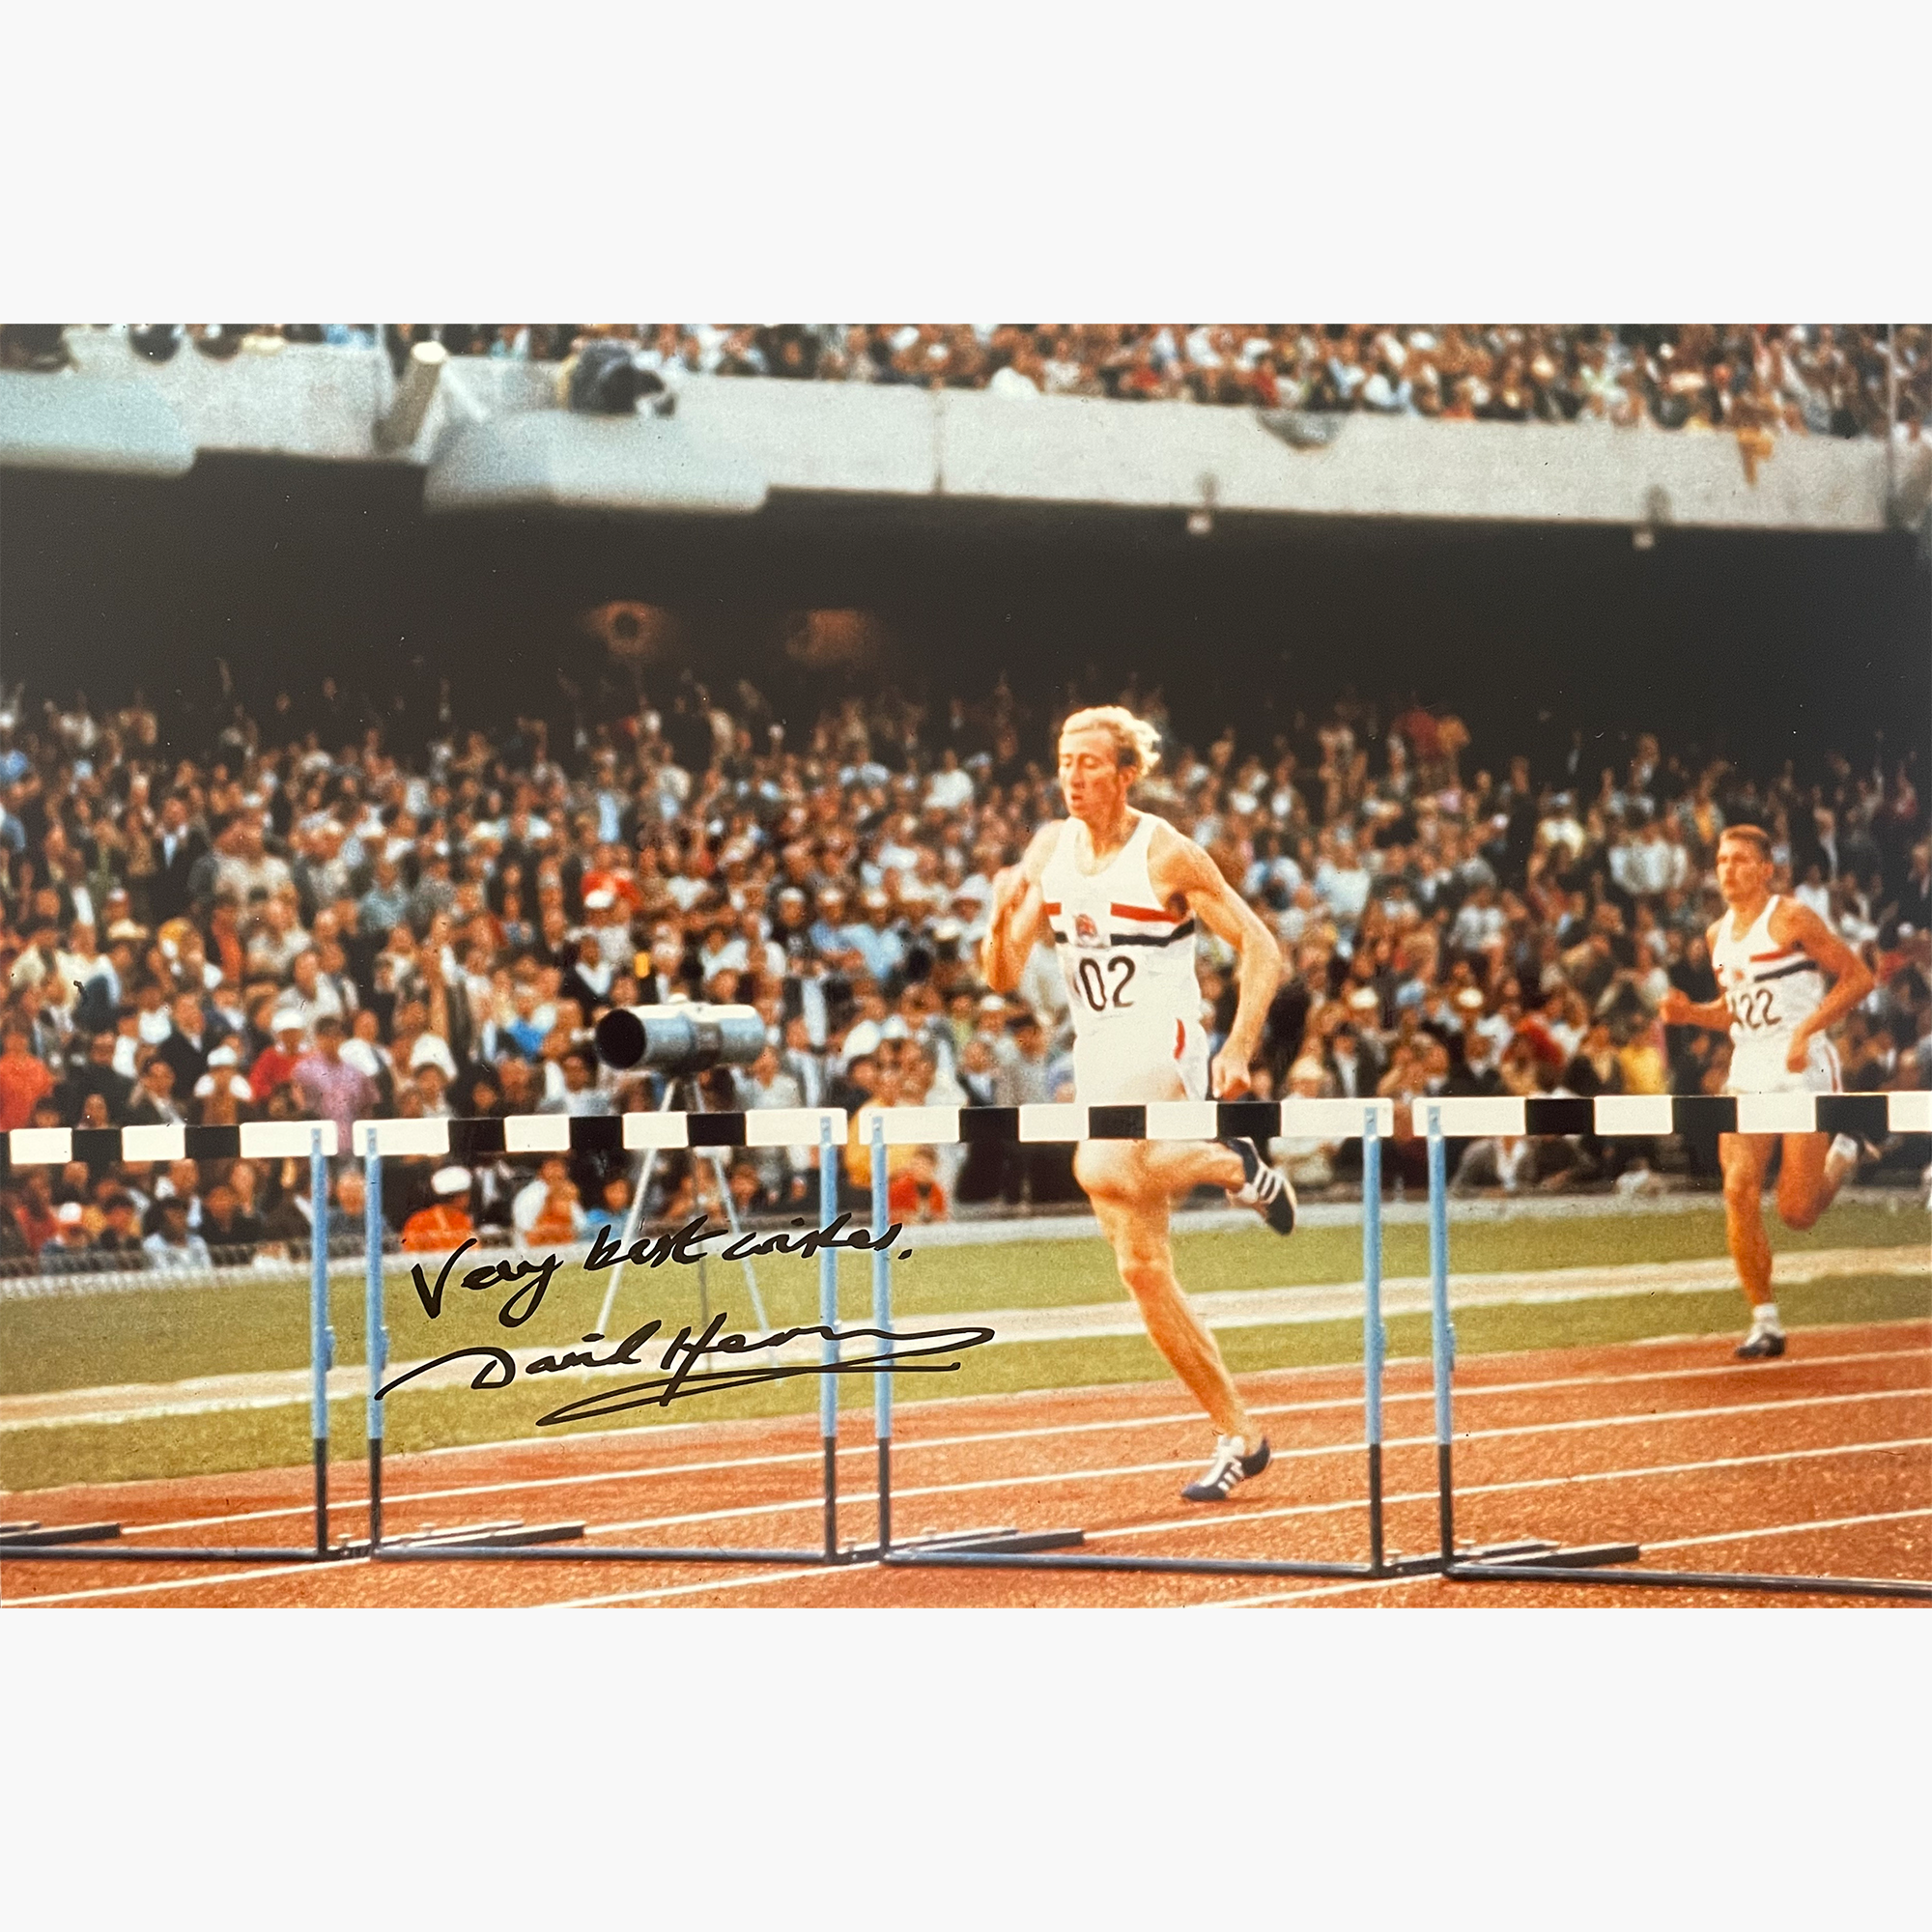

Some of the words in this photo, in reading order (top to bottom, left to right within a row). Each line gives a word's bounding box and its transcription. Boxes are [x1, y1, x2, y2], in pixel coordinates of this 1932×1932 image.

[1072, 955, 1136, 1011] 02
[411, 1238, 563, 1327] Very
[583, 1214, 728, 1271] best
